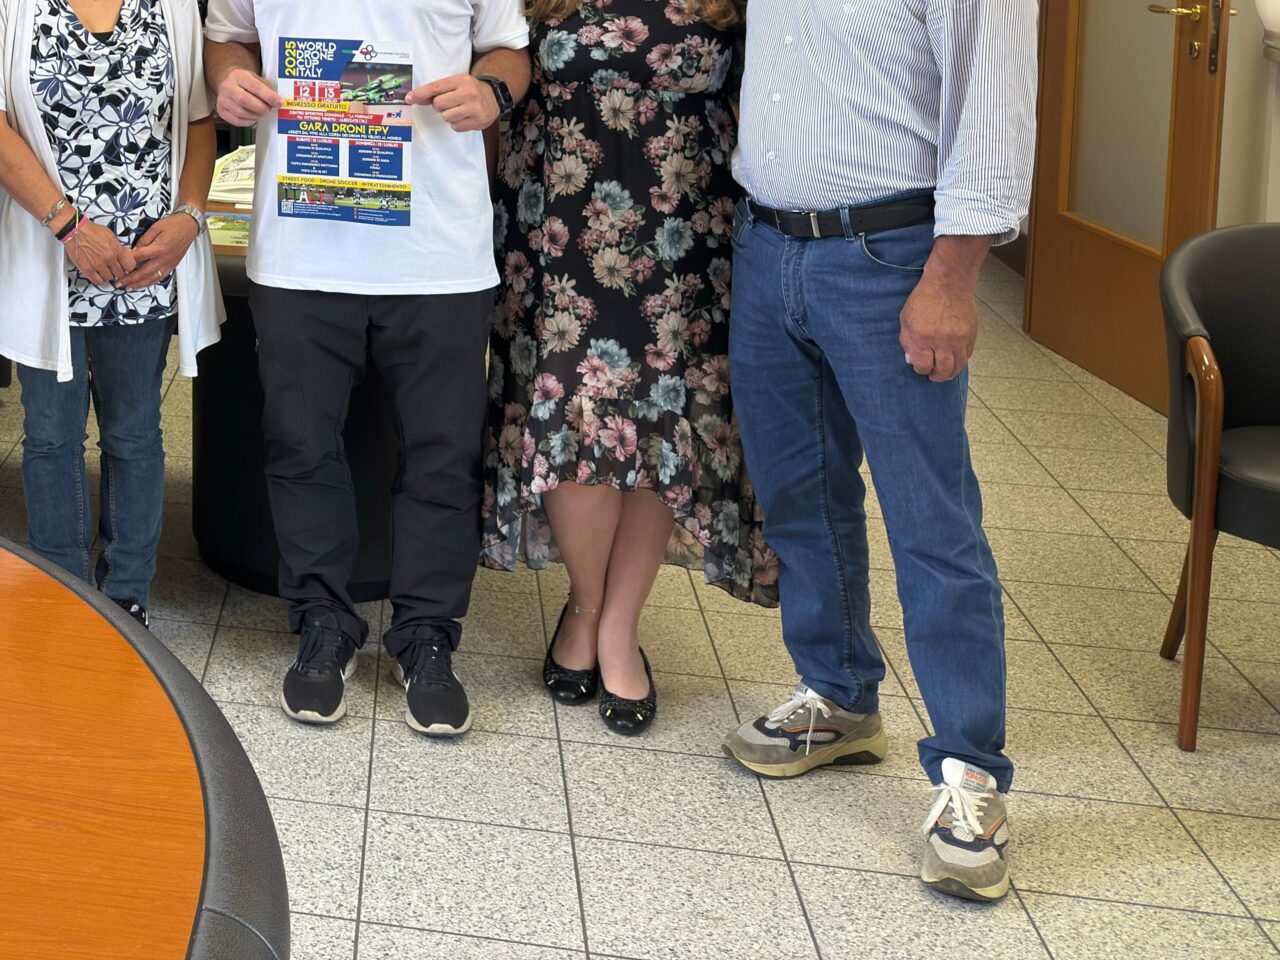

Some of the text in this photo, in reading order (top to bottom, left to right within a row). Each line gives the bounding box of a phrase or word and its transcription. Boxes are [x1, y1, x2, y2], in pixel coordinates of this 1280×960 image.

[296, 41, 336, 51] WORLD
[285, 41, 296, 76] 2025
[296, 50, 334, 61] DRONE
[297, 60, 319, 68] CUP
[295, 67, 322, 77] ITALY
[300, 86, 310, 97] 12
[325, 88, 335, 98] 13
[317, 102, 347, 110] GRATUITO
[299, 121, 389, 135] GARA DRONI FPV
